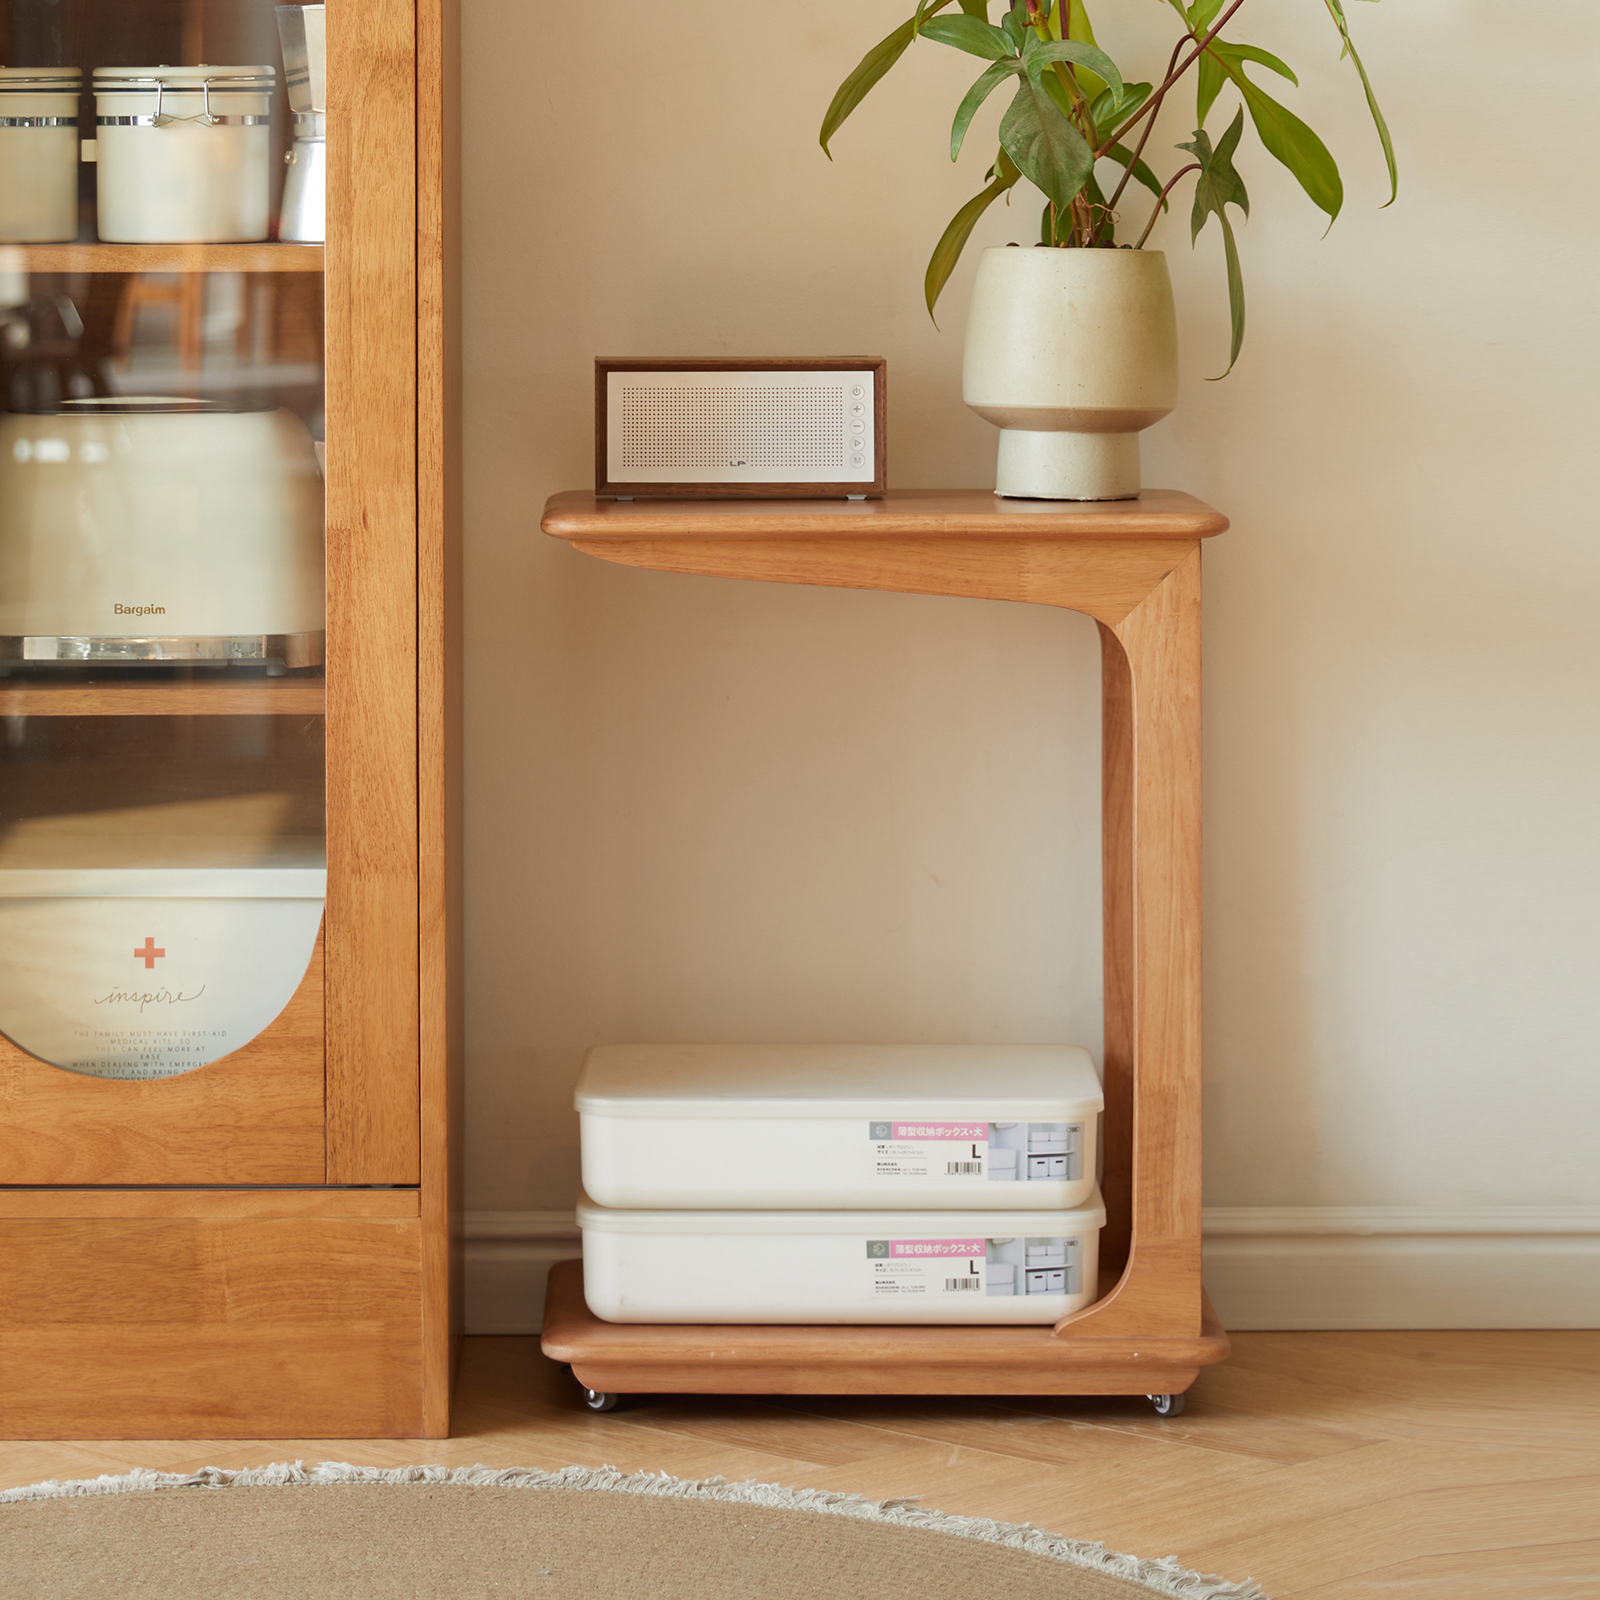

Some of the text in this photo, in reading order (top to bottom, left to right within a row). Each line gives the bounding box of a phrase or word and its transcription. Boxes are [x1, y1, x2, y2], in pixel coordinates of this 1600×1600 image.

[114, 603, 166, 617] Bargaim
[94, 984, 206, 1014] inspire
[972, 1144, 982, 1159] L
[970, 1260, 980, 1275] L
